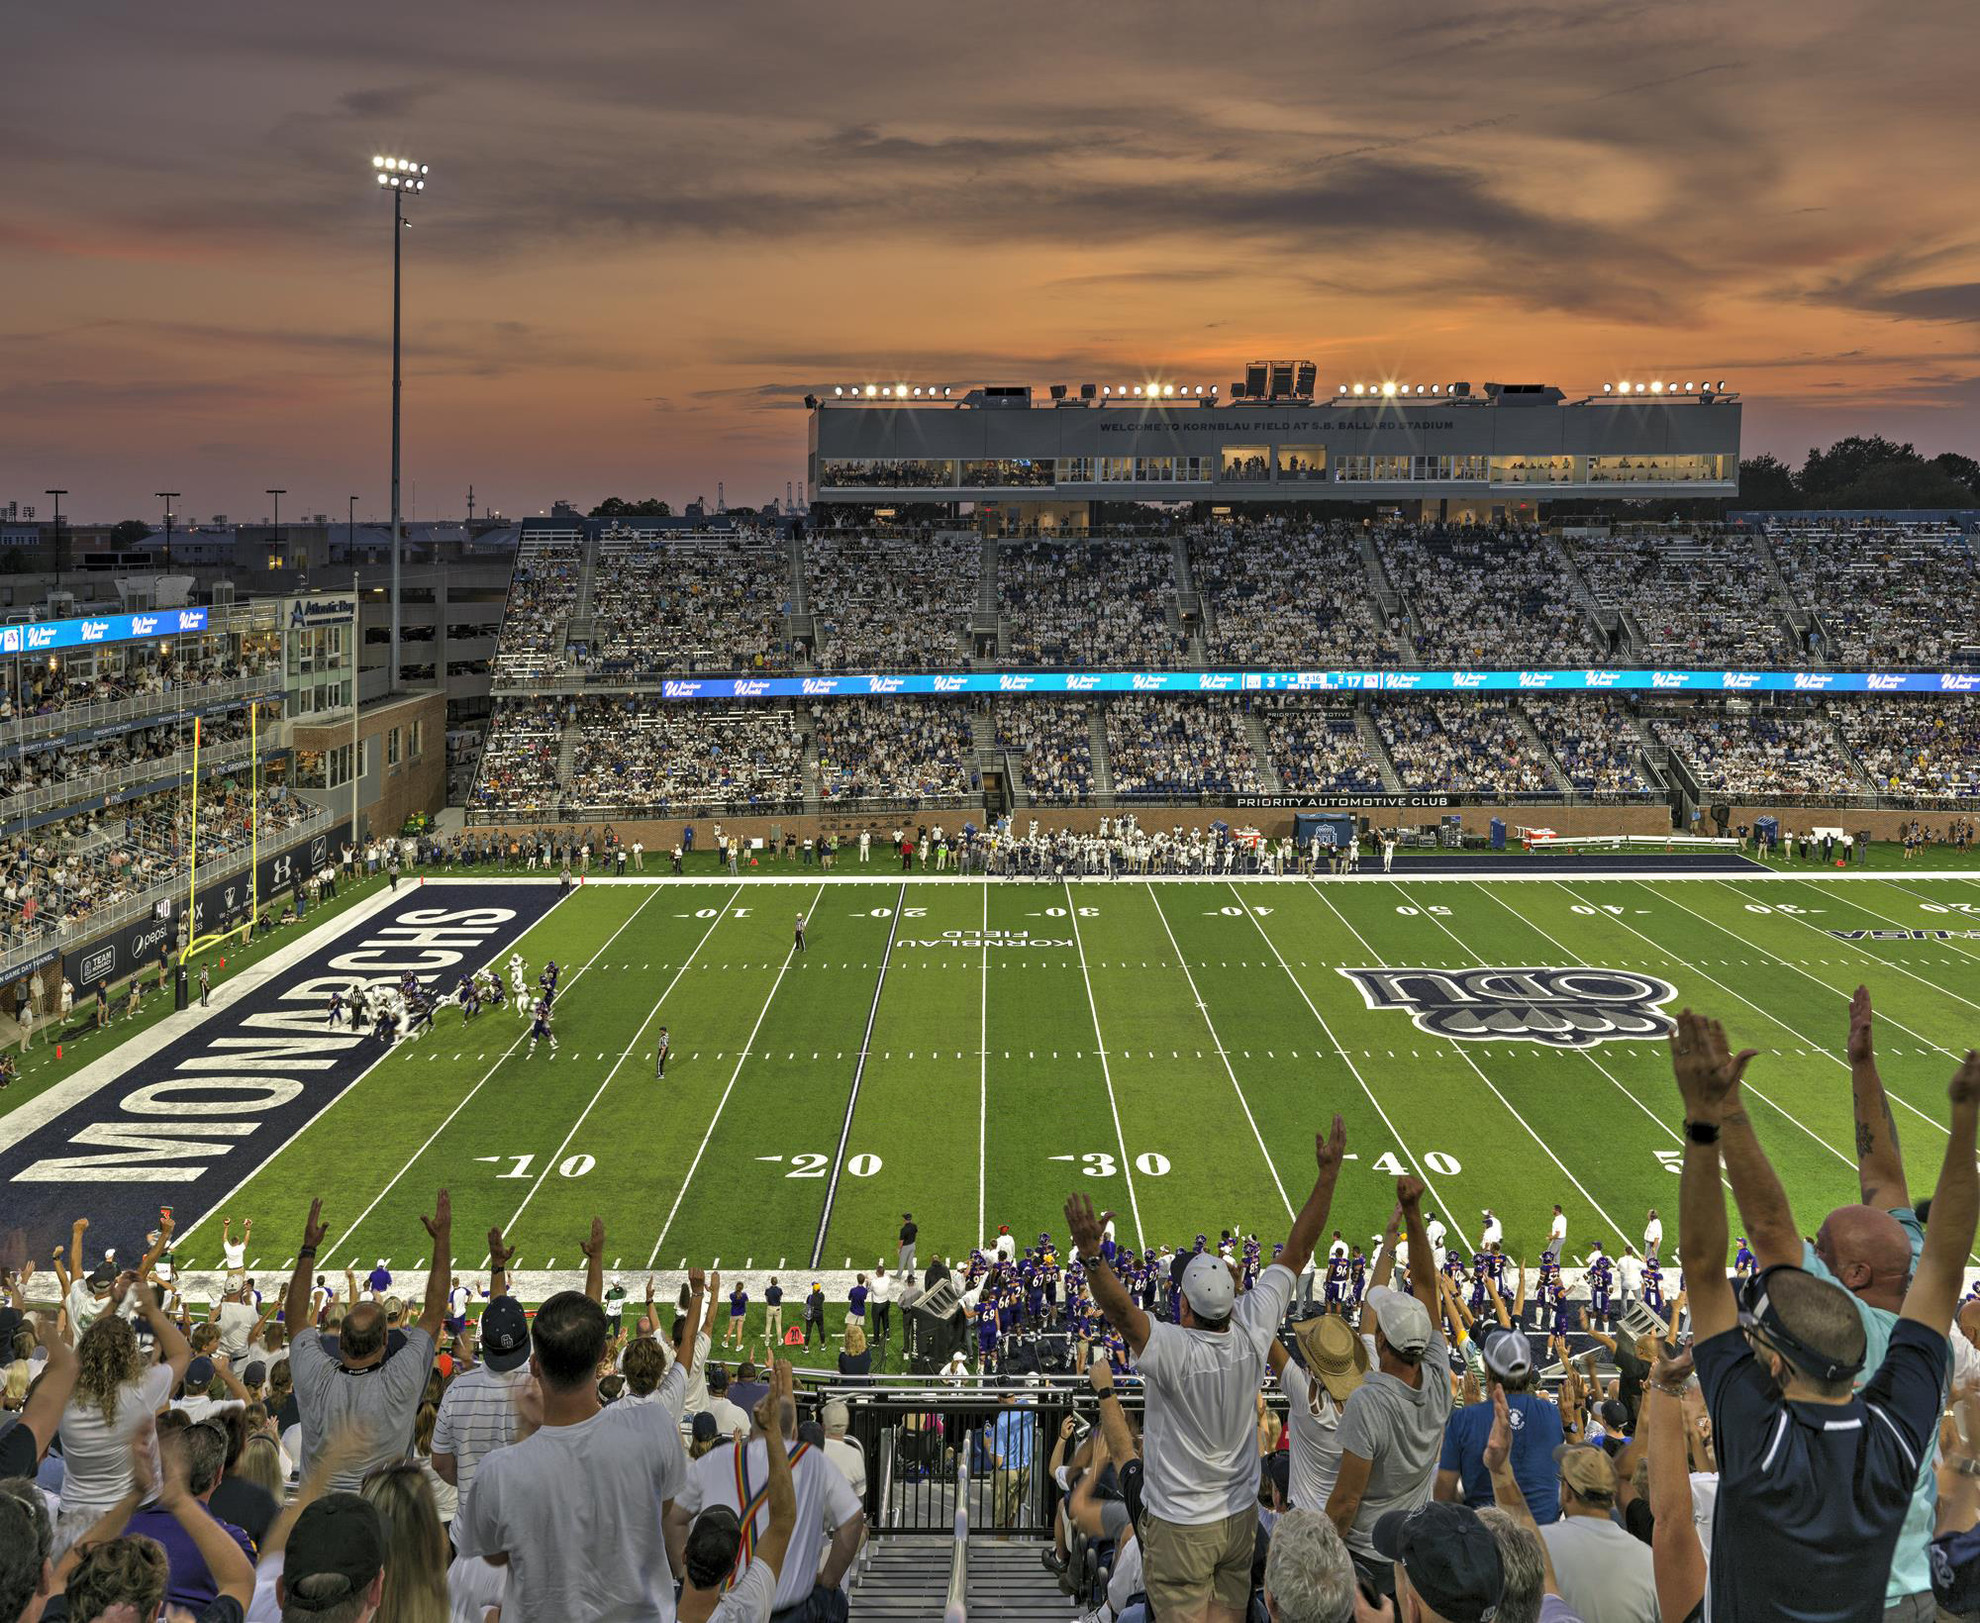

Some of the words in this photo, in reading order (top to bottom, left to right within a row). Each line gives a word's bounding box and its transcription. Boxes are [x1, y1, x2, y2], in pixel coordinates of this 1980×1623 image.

[1101, 423, 1161, 431] WELCOME
[1164, 423, 1180, 431] TO
[1183, 422, 1249, 431] KORNBLAU
[1254, 422, 1290, 431] FIELD
[1293, 422, 1309, 430] AT
[1312, 422, 1335, 430] S.B.
[1338, 422, 1396, 430] BALLARD
[1400, 421, 1453, 429] STADIUM
[1267, 676, 1276, 687] 3
[1346, 676, 1361, 687] 17
[1237, 798, 1301, 807] PRIORITY
[1308, 798, 1406, 807] AUTOMOTIVE
[1411, 797, 1448, 806] CLUB
[157, 899, 171, 918] 40
[144, 923, 169, 949] pepsi
[942, 930, 1029, 938] FIELD
[897, 939, 1075, 948] KORNBLAU
[93, 950, 112, 966] TEAM
[5, 967, 20, 981] GAME
[21, 963, 33, 973] DAY
[1342, 971, 1653, 1002] ODU
[496, 1154, 596, 1178] 10
[785, 1153, 882, 1178] 20
[1082, 1153, 1171, 1177] 30
[1372, 1152, 1462, 1177] 40
[1336, 1265, 1348, 1277] 96
[1032, 1273, 1045, 1287] 67
[1067, 1282, 1079, 1297] 24
[998, 1295, 1011, 1309] 66
[982, 1309, 995, 1322] 68
[791, 1329, 800, 1342] 20
